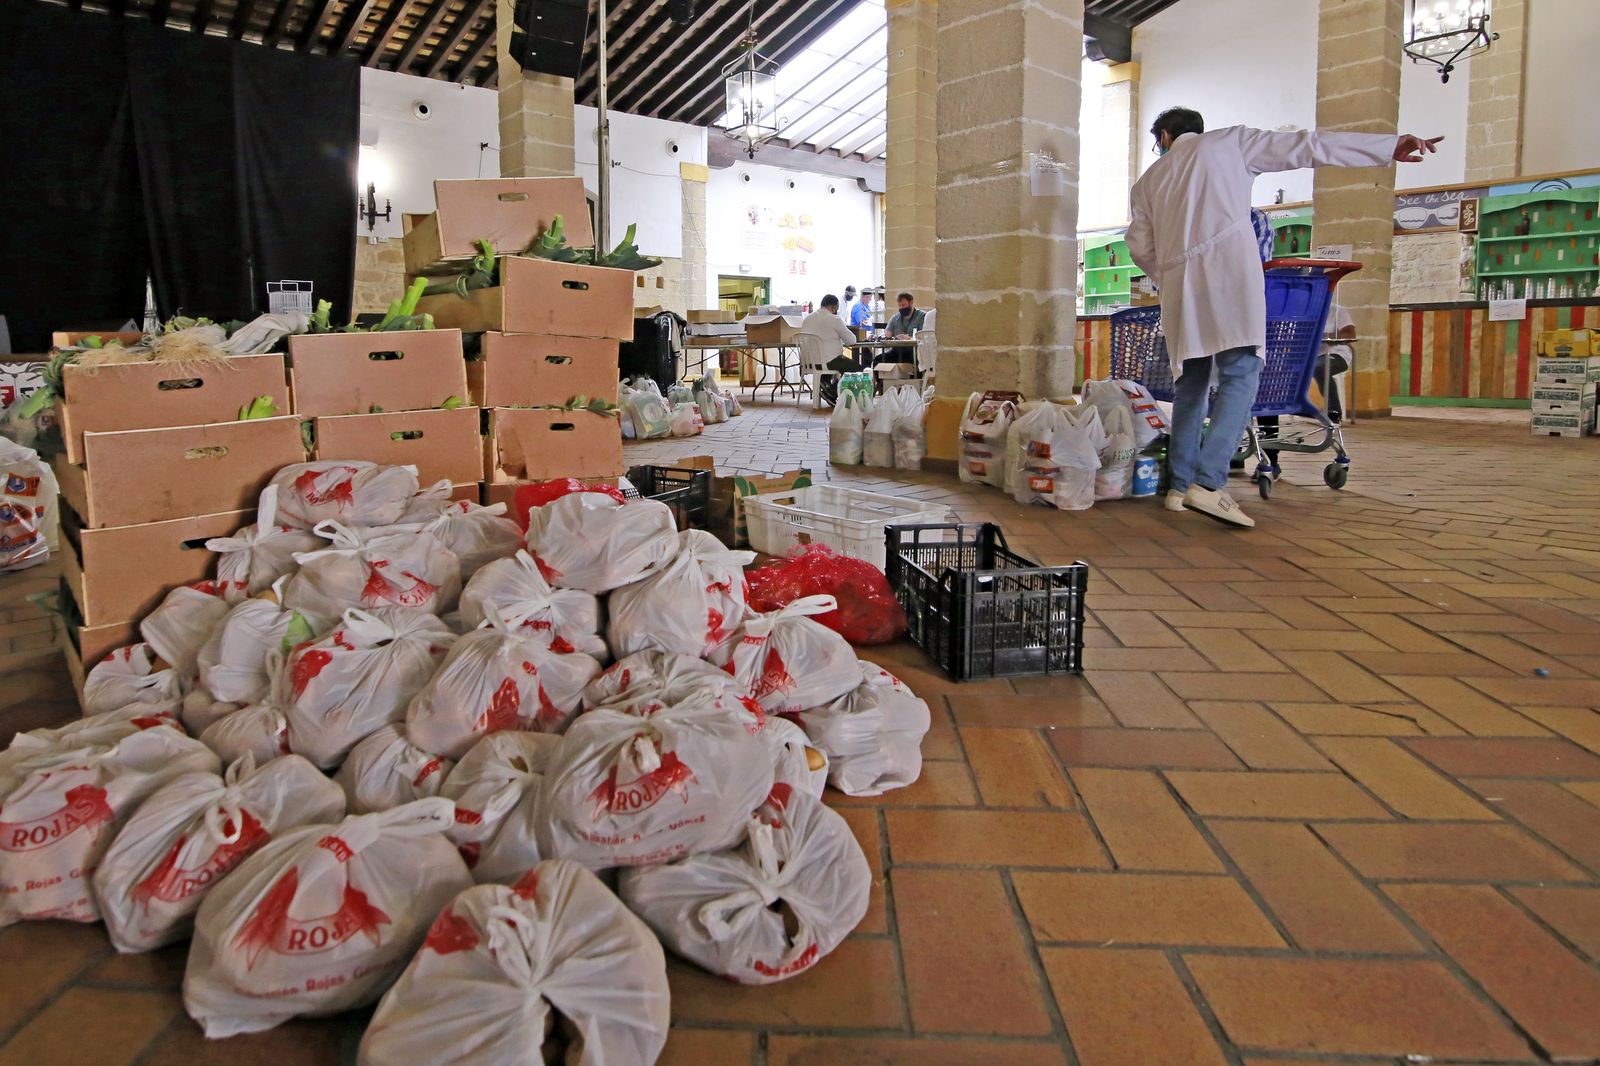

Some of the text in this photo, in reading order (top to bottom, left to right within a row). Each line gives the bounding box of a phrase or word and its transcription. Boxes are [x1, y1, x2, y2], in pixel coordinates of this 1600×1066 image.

[1397, 194, 1422, 207] See
[1424, 193, 1439, 204] the
[615, 774, 670, 811] ROJA
[12, 799, 96, 848] ROJAS
[25, 876, 62, 893] Rojas
[288, 914, 360, 951] ROJA
[306, 975, 345, 991] Rojas
